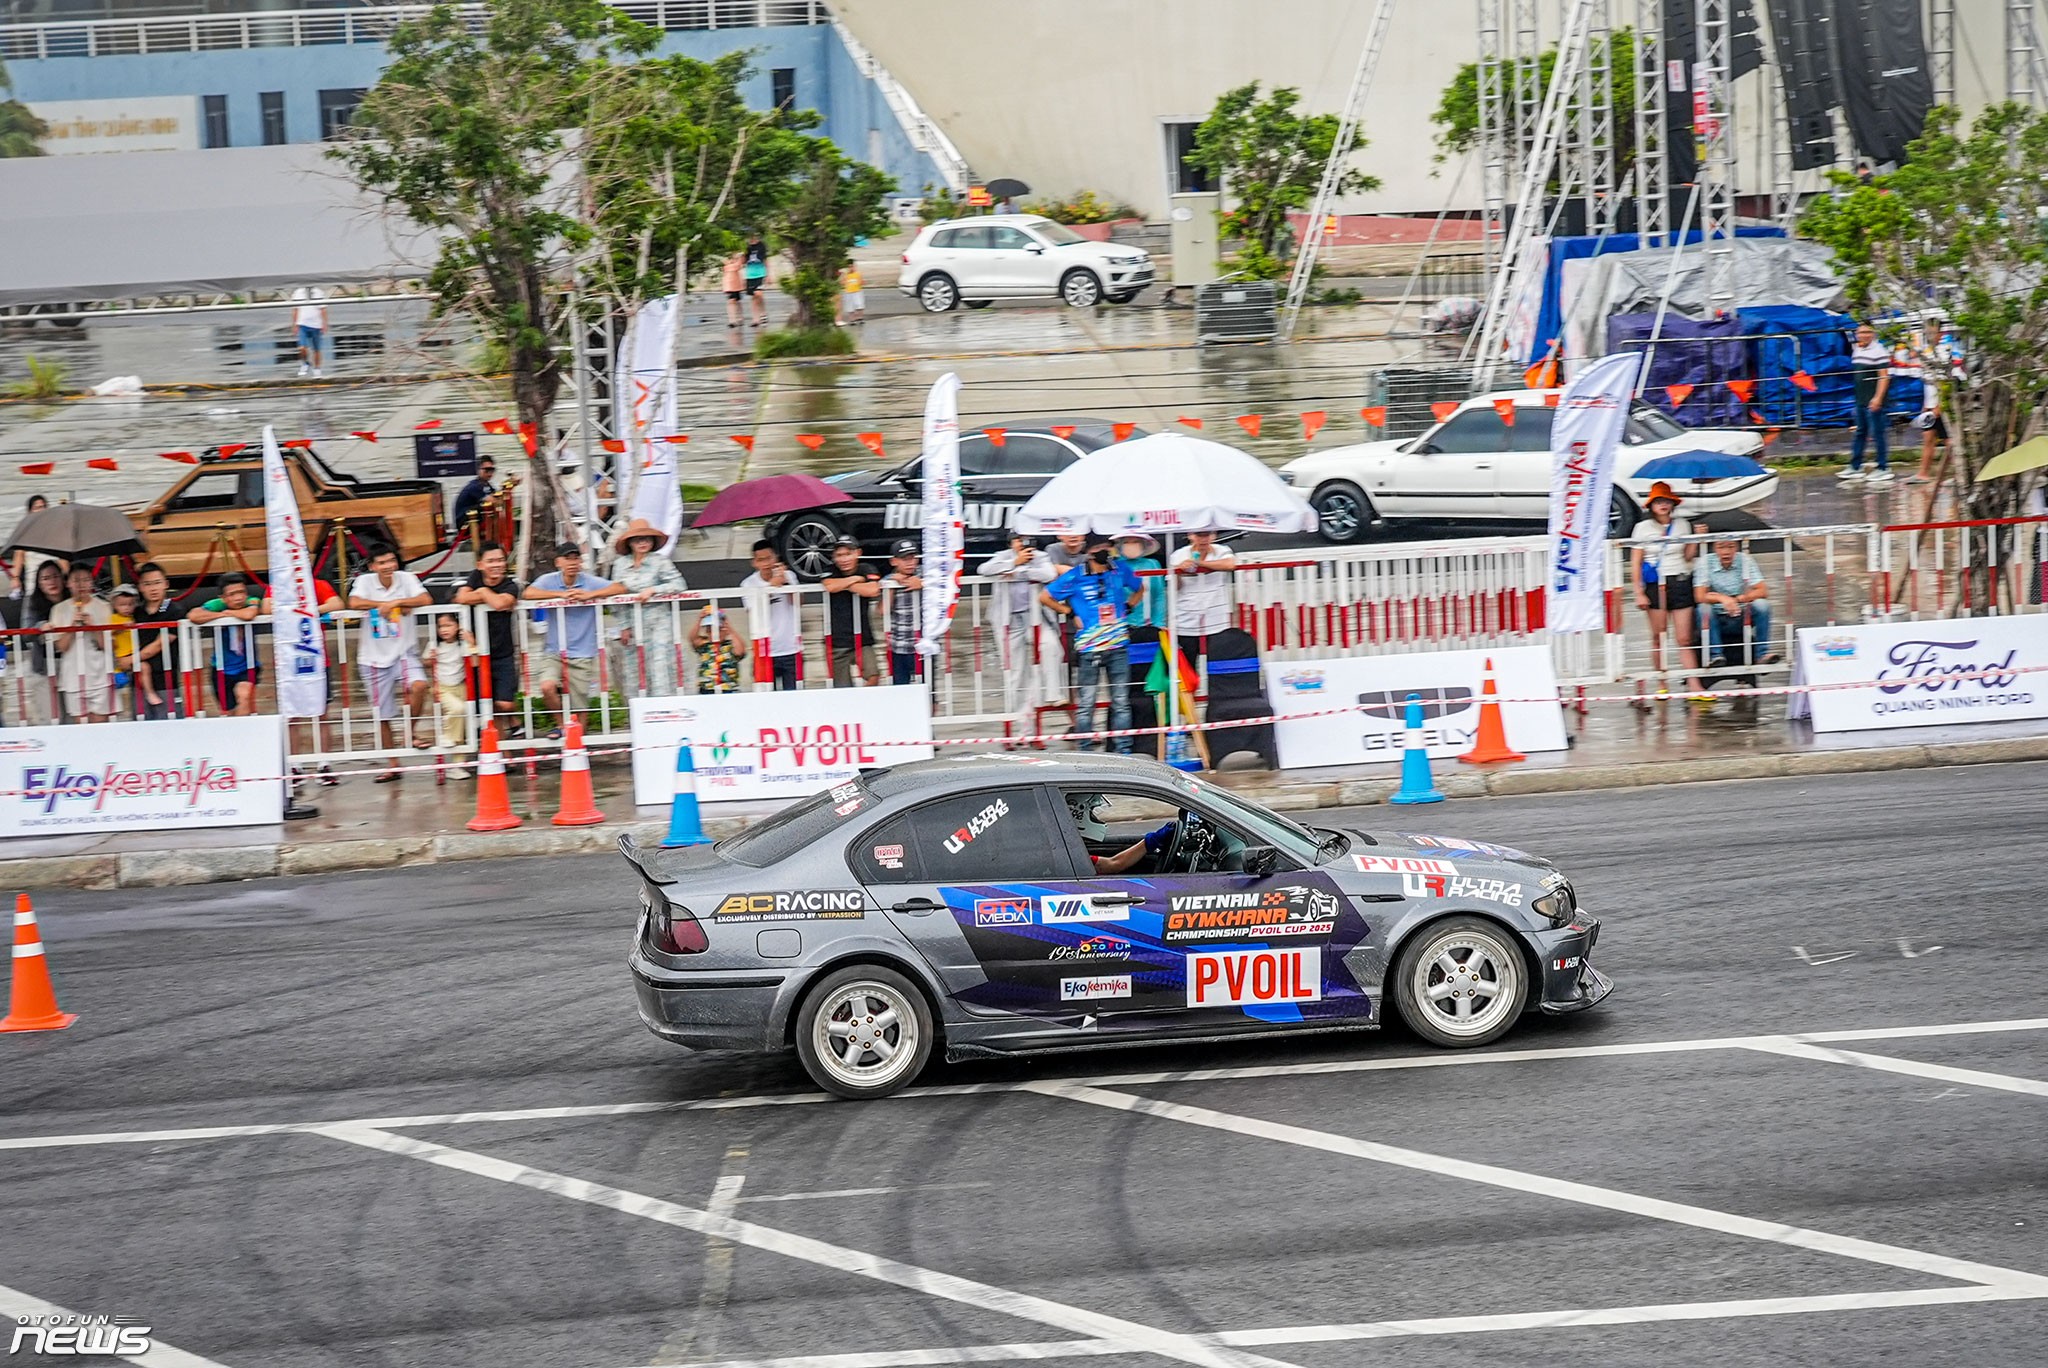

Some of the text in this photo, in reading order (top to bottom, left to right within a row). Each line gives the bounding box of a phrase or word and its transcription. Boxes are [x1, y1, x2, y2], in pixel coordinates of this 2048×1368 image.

[1878, 640, 2019, 694] Ford
[1873, 692, 2036, 715] QUANG NINH FORD
[759, 723, 876, 768] PVOIL
[24, 757, 238, 813] Ekokemika
[967, 798, 1008, 829] ULTRA
[971, 806, 1010, 838] RACING
[1359, 856, 1453, 874] PVOIL
[1451, 876, 1523, 893] ULTRA
[717, 893, 862, 913] BC RACING
[1171, 893, 1260, 911] VIETNAM
[1447, 888, 1524, 907] RACING
[717, 914, 761, 923] EXCLUSIVELY
[763, 913, 805, 921] DISTRIBUTED
[817, 910, 862, 919] VIETPASSION
[979, 912, 1031, 924] MEDIA
[1168, 908, 1288, 929] GYMKHANA
[1166, 924, 1332, 941] CHAMPIONSHIP PVOIL CUP 2025
[1195, 952, 1313, 1003] PVOIL
[1064, 979, 1128, 997] Ekokemika
